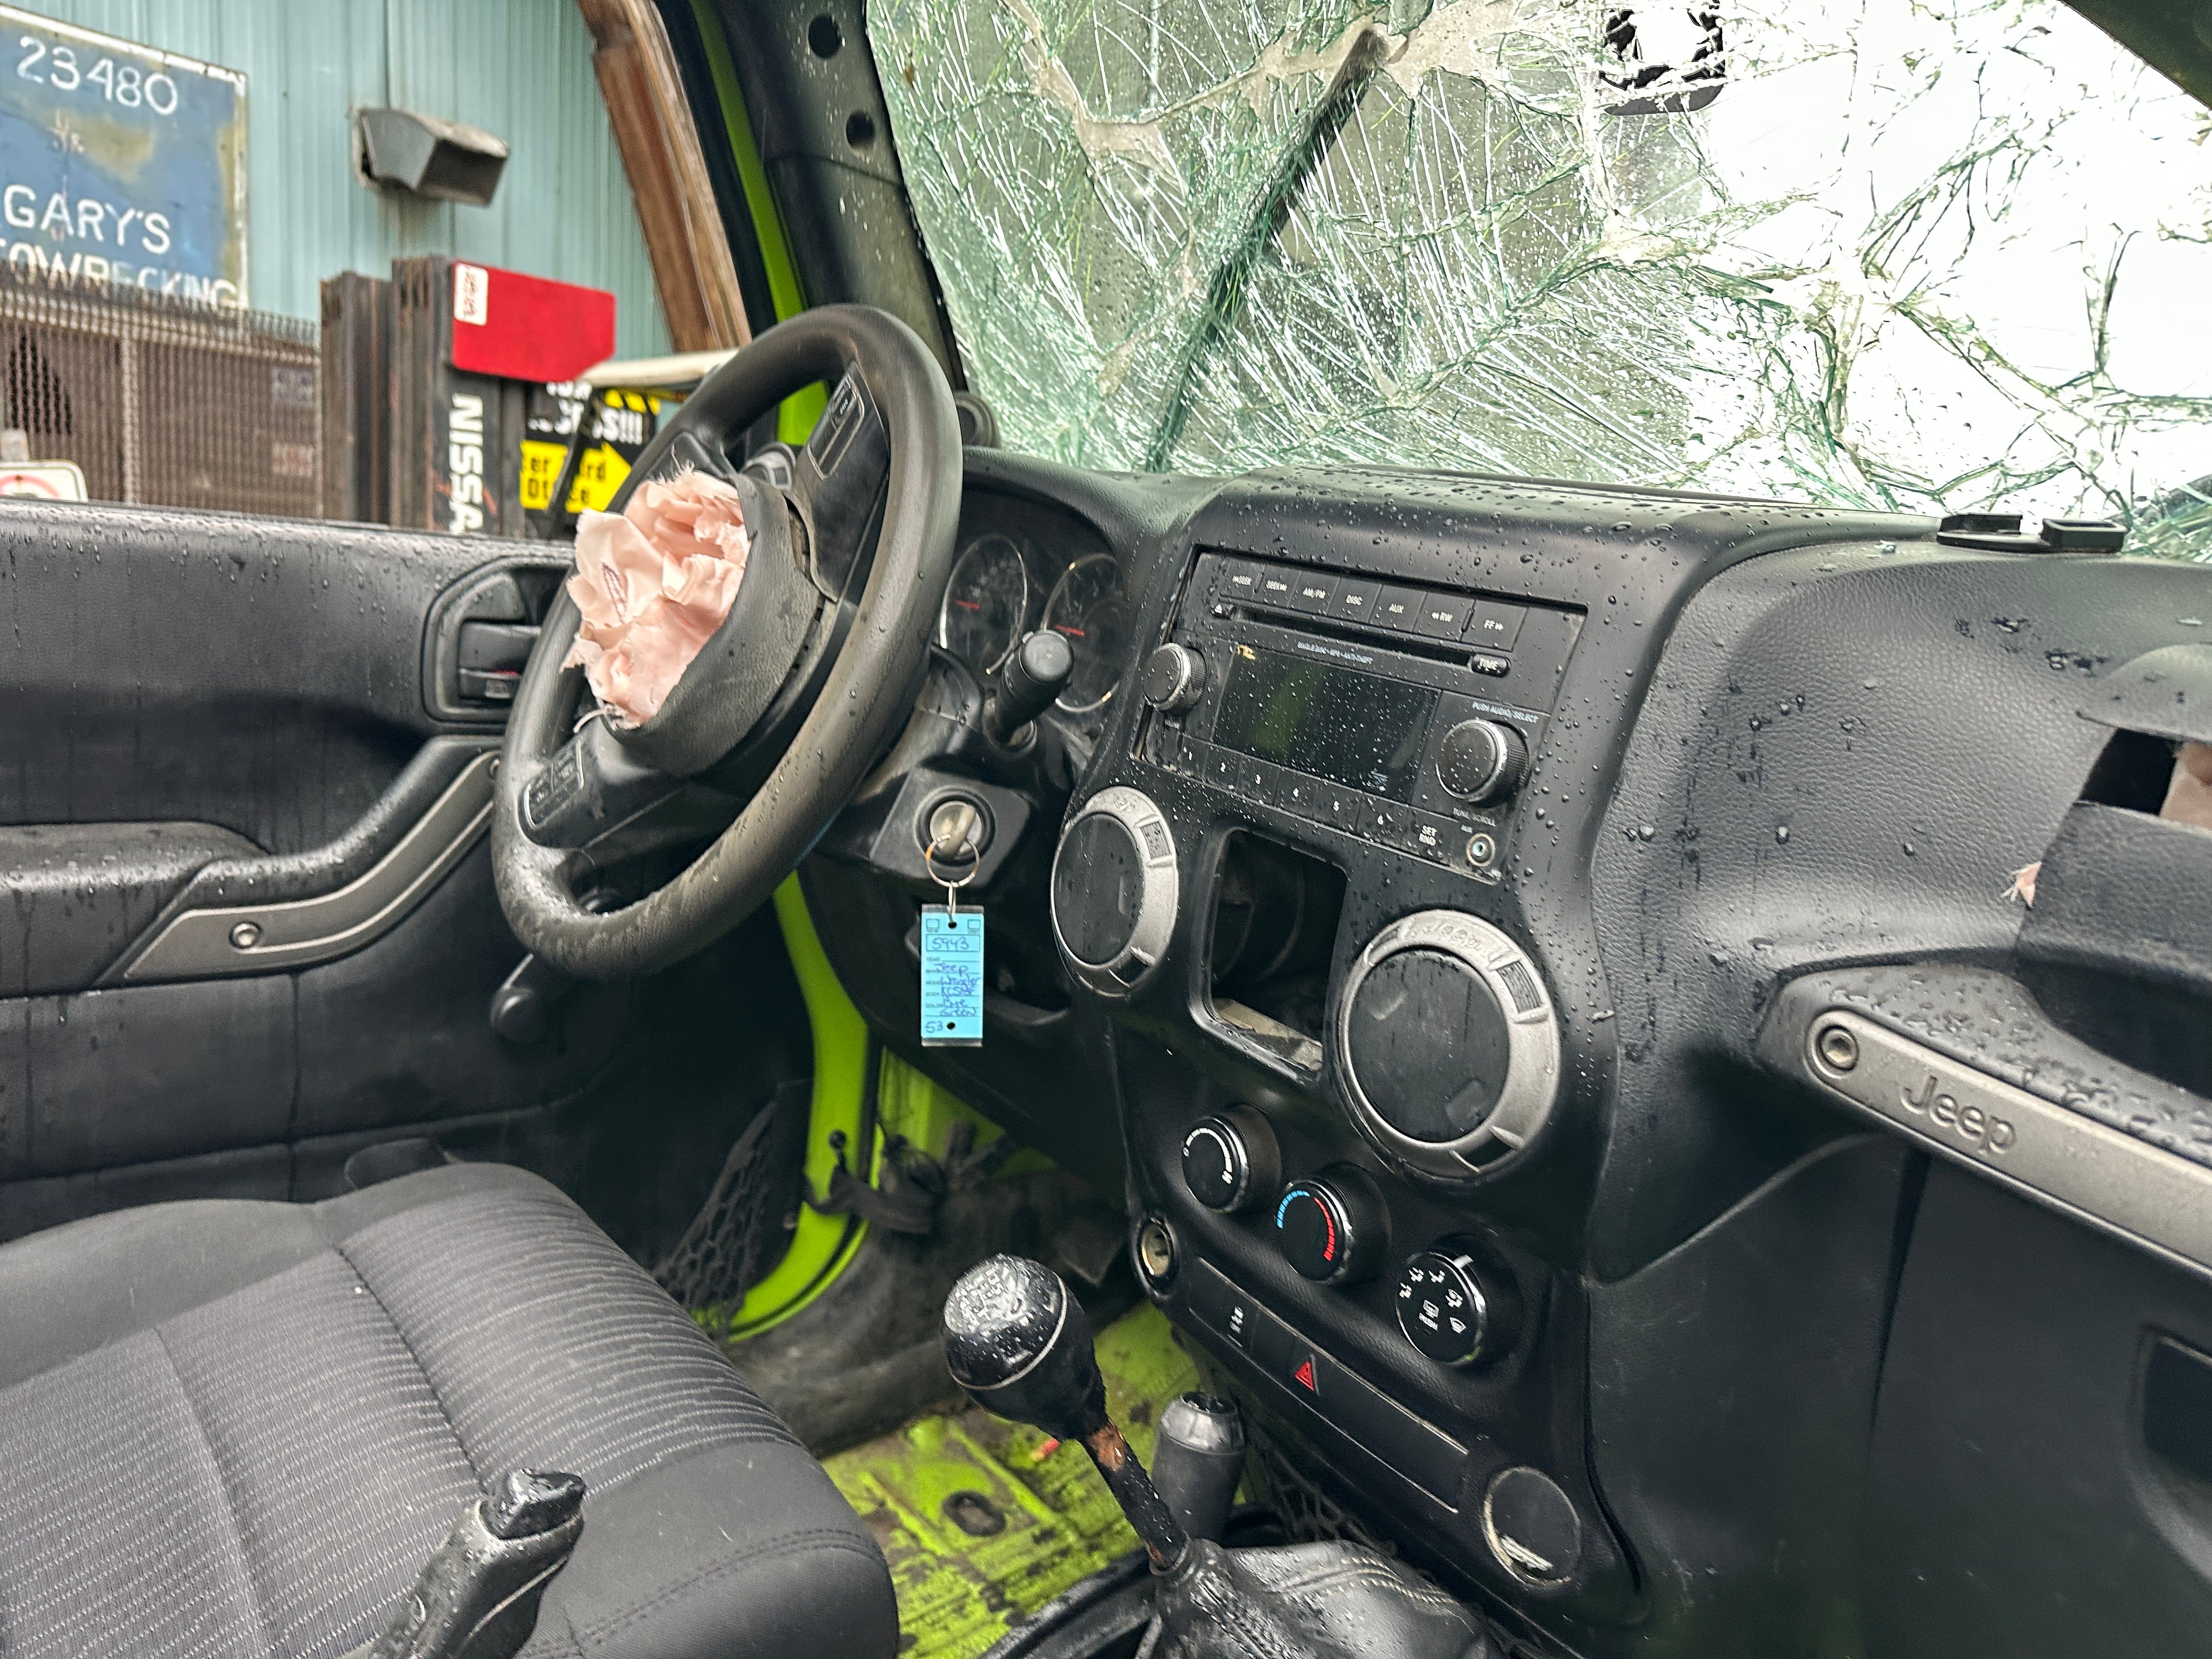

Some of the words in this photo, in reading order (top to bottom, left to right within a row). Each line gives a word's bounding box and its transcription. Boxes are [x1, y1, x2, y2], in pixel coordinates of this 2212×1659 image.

[17, 36, 178, 115] 23480
[4, 184, 171, 255] GARY'S
[0, 239, 239, 305] OWRECKING
[449, 392, 483, 535] NISSA
[1303, 587, 1325, 599] AM/FM
[1346, 594, 1363, 605] DISC
[1388, 604, 1404, 613] AUX
[1377, 815, 1384, 825] 6
[1421, 824, 1438, 837] SET
[1419, 833, 1437, 847] RND
[931, 936, 969, 950] 5943
[1433, 919, 1481, 950] Jeep
[934, 963, 969, 977] Jeep
[925, 1021, 944, 1033] 53
[1901, 1075, 2016, 1156] Jeep
